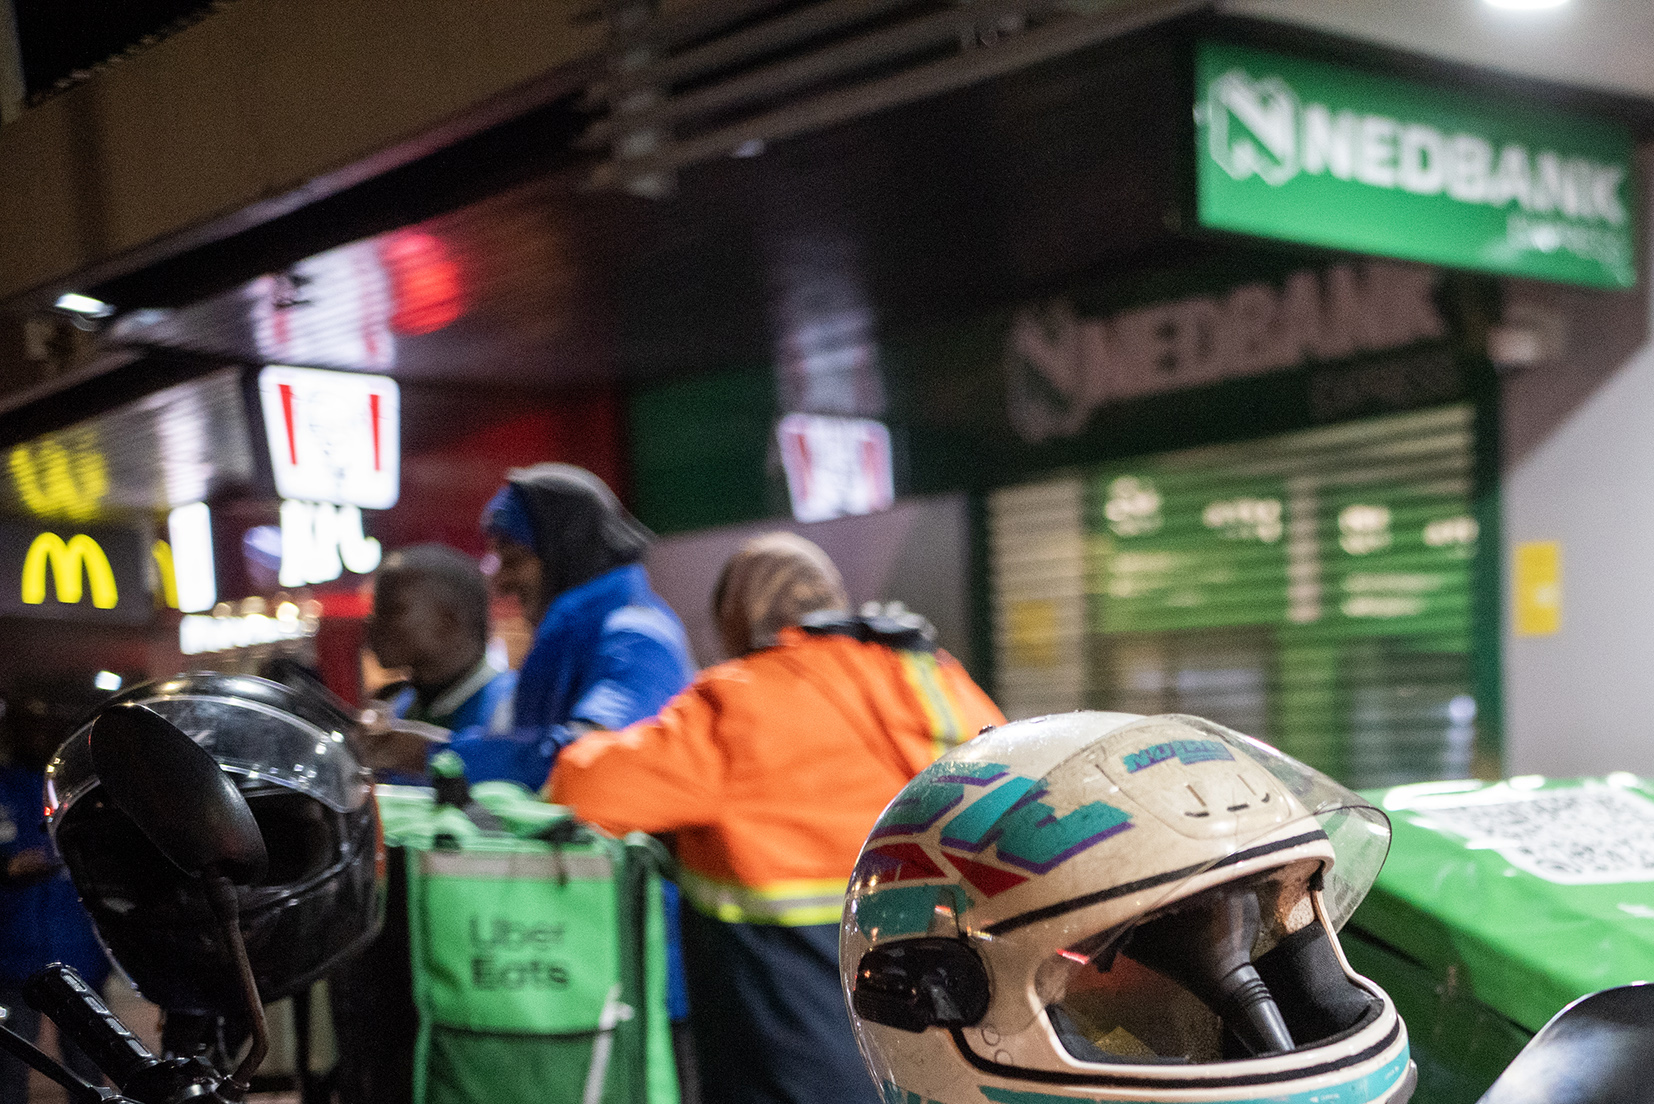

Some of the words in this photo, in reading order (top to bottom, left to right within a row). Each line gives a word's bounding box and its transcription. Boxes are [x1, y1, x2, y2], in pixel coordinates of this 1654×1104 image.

[1301, 101, 1628, 228] NEDBANK
[1081, 262, 1447, 403] NEDBANK
[470, 914, 567, 948] Uber
[471, 957, 569, 990] Eats
